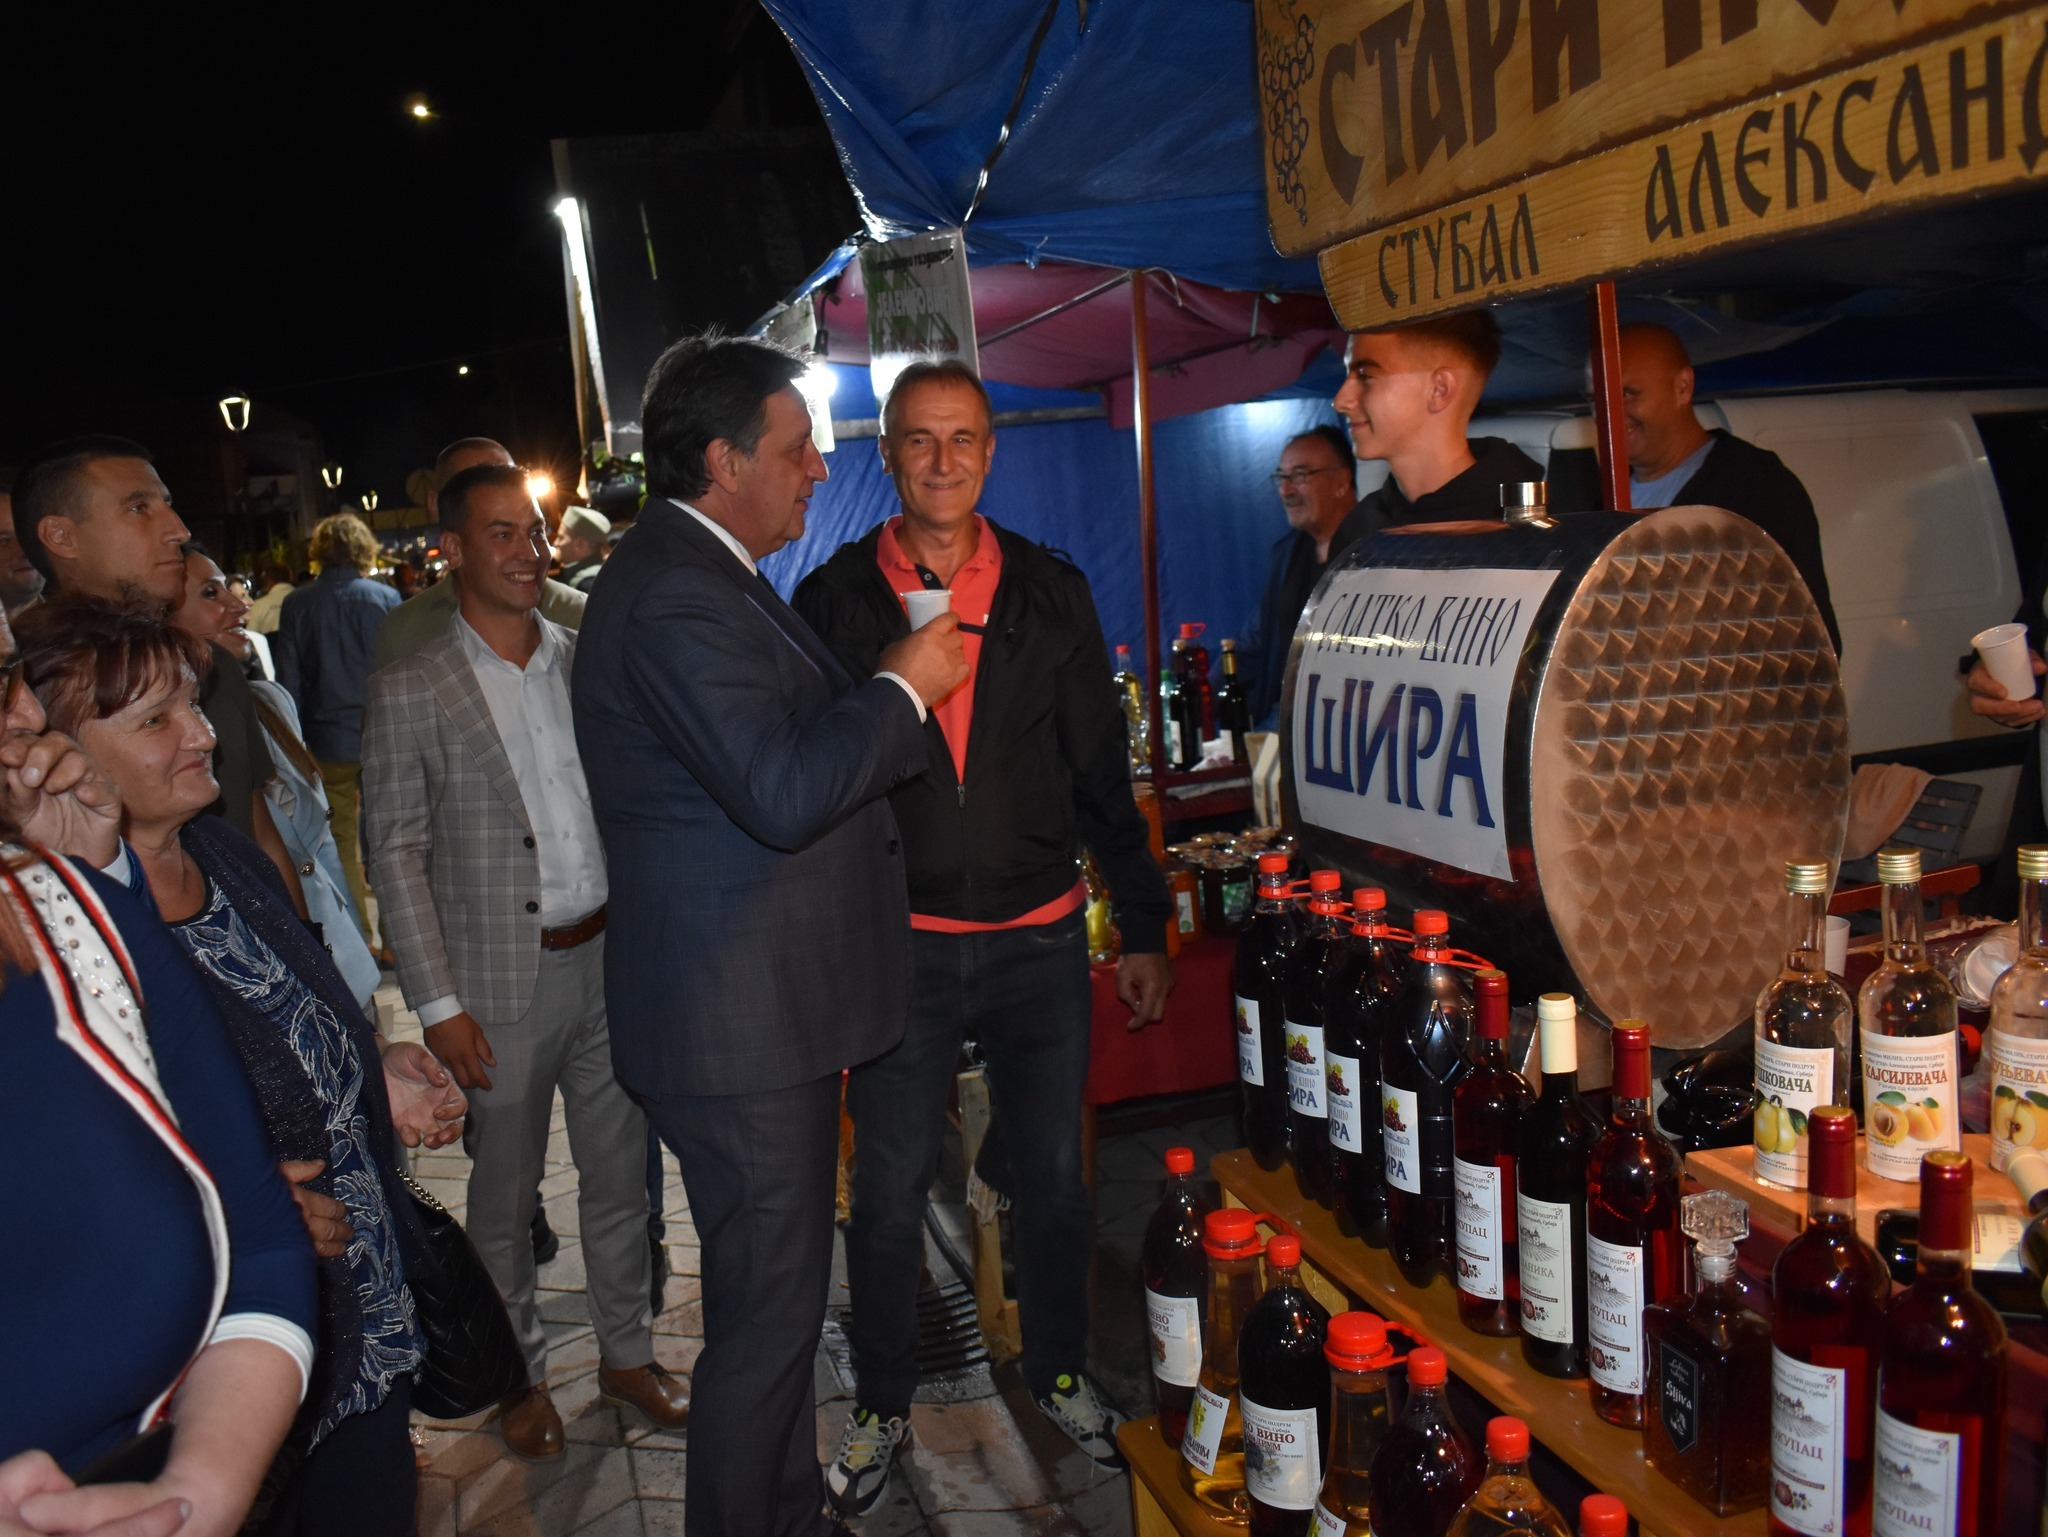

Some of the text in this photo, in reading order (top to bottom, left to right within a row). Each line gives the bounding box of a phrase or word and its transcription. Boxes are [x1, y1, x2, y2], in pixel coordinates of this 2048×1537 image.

[1318, 0, 1603, 207] СТАРИ
[1378, 191, 1541, 310] СТУБАЛ
[1304, 674, 1496, 829] ШИРА
[1757, 1067, 1814, 1093] ШКОВАЧА
[1865, 1063, 1948, 1086] КАЈСИЈЕВАЧА
[1991, 1058, 2048, 1085] УЊЕВА
[1289, 1084, 1319, 1109] ИРА
[1521, 1258, 1555, 1279] АНИКА
[1590, 1303, 1628, 1328] КУПАЦ
[1665, 1379, 1693, 1410] Šljiva
[1256, 1427, 1296, 1444] ВИНО
